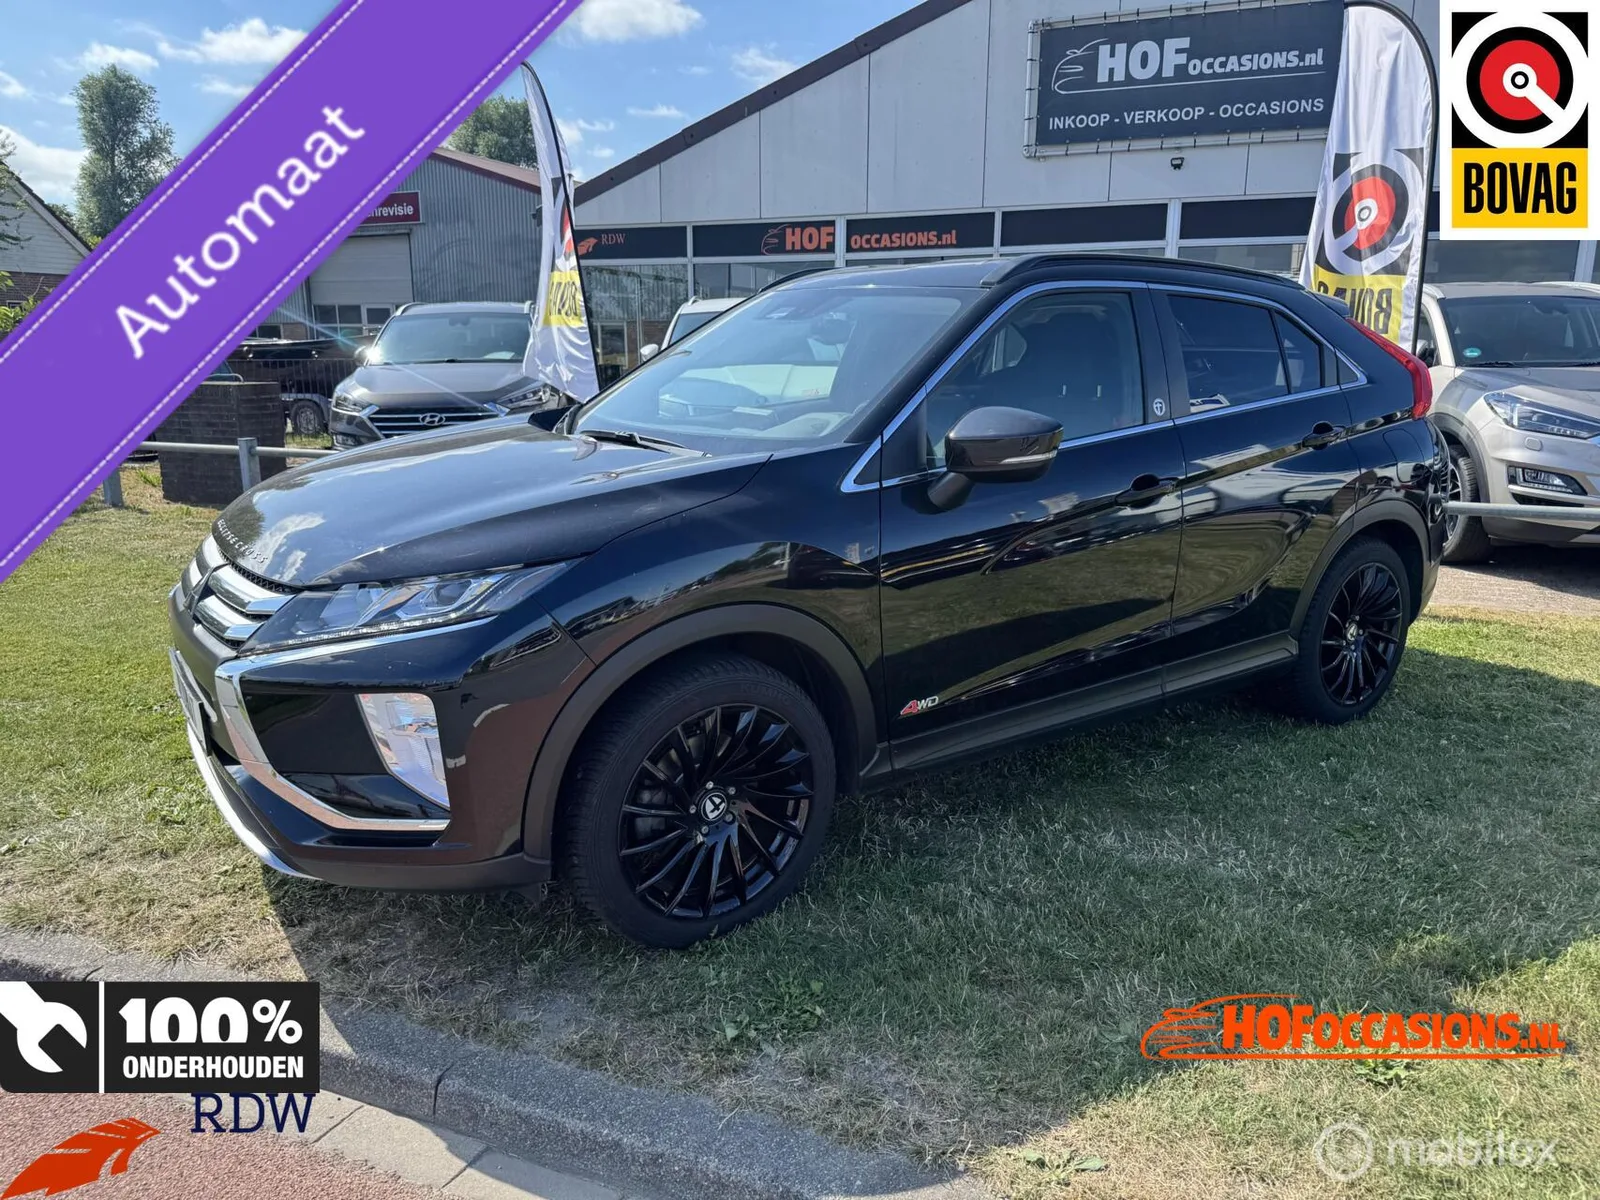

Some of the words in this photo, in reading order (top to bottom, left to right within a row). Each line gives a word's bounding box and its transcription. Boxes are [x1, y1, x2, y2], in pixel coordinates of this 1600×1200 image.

[1049, 113, 1110, 130] INKOOP
[1123, 106, 1205, 125] VERKOOP
[1219, 98, 1325, 119] OCCASIONS
[368, 202, 414, 218] nrevisie
[601, 233, 626, 246] RDW
[785, 225, 835, 251] HOF
[850, 229, 957, 249] OCCASIONS.nl
[900, 695, 939, 716] 4WD
